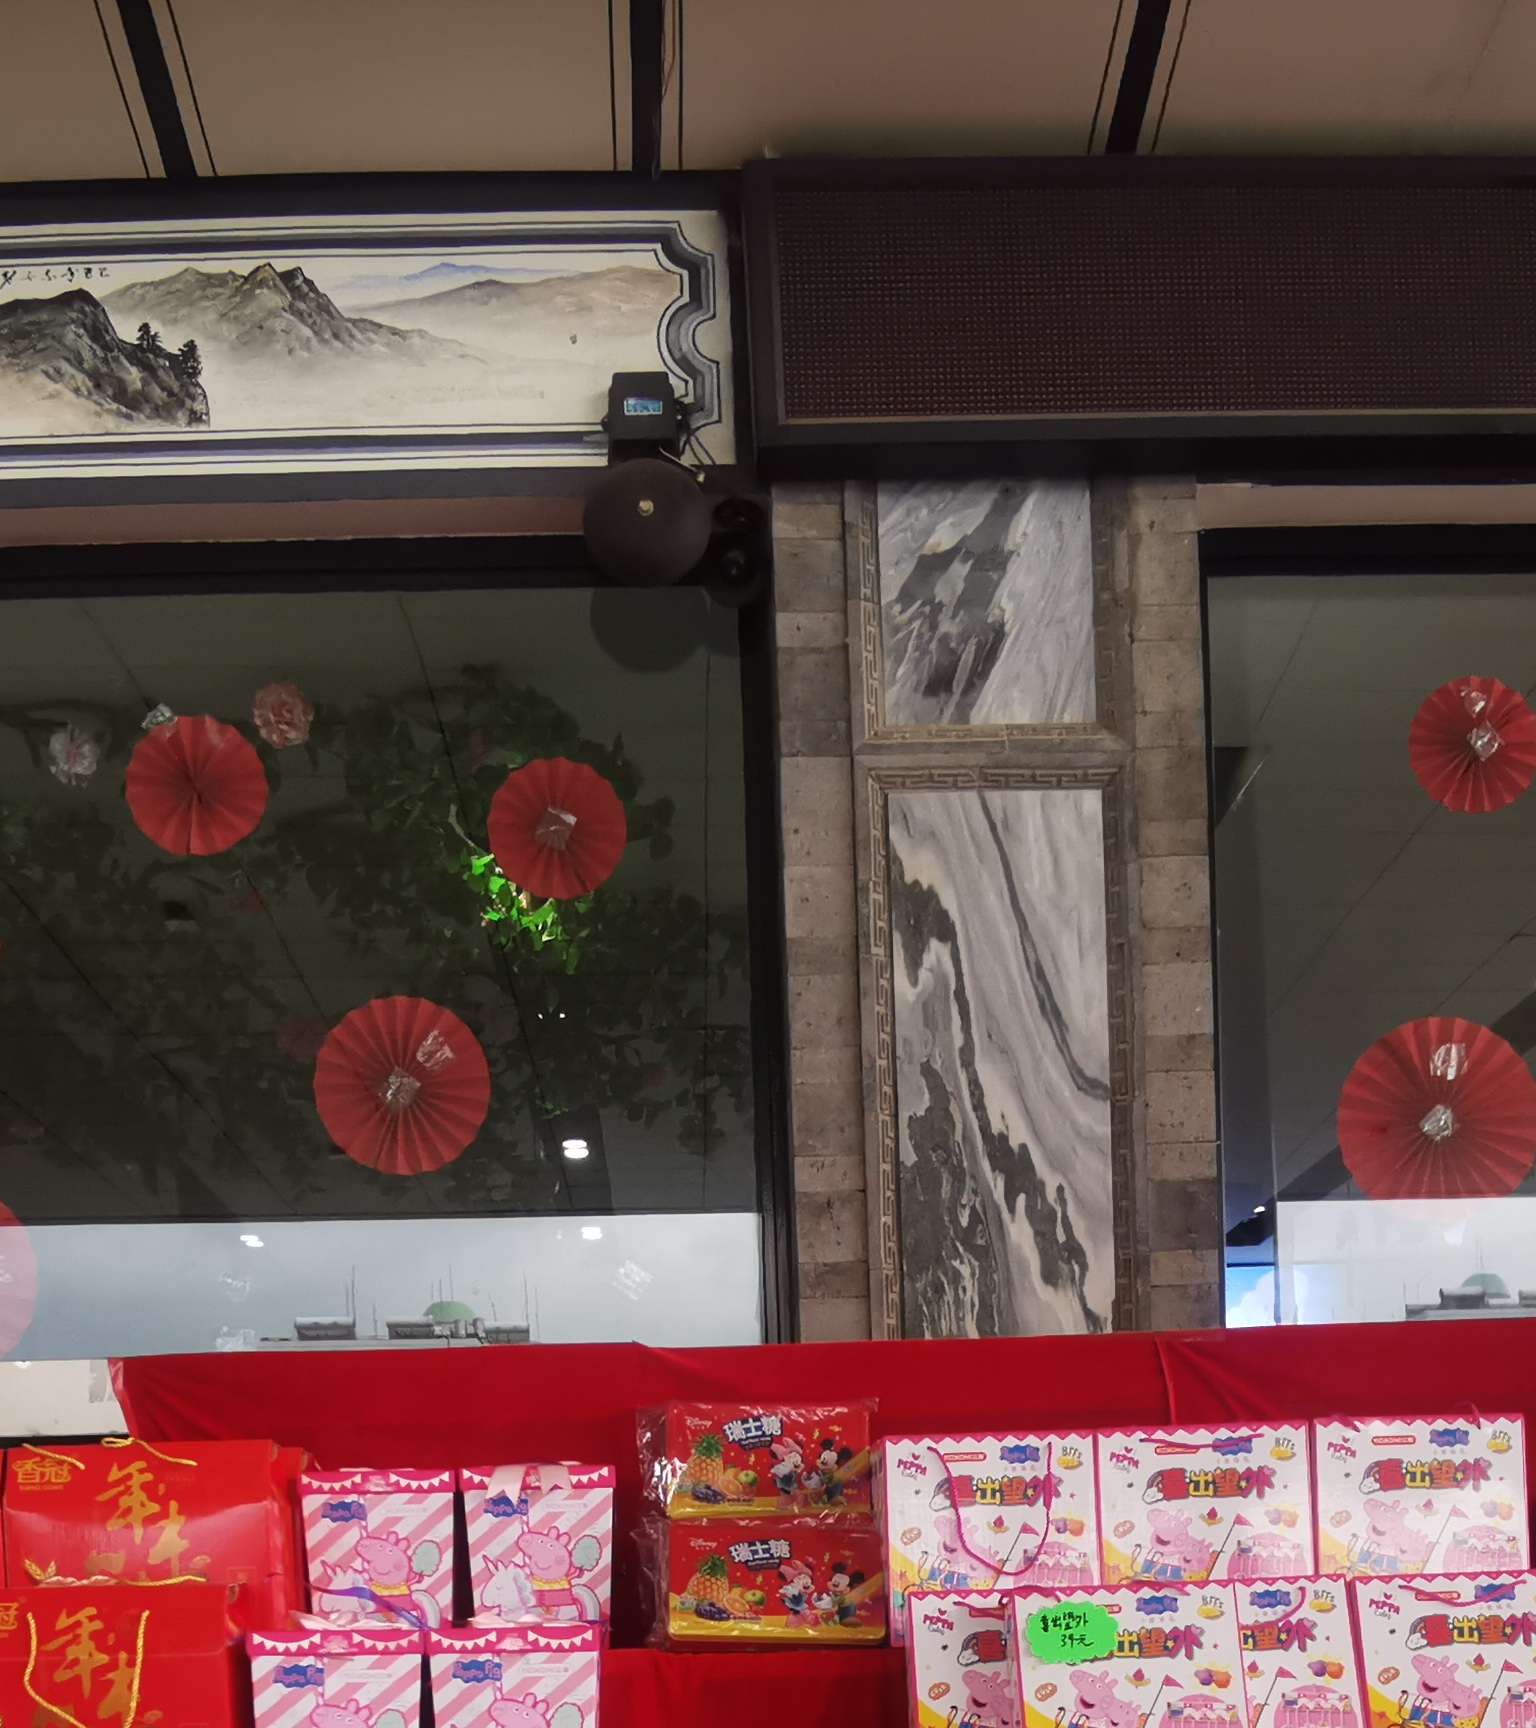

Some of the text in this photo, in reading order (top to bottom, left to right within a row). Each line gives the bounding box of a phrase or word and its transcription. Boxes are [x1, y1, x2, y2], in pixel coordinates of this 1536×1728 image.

[724, 1416, 782, 1442] 瑞士糖
[729, 1540, 791, 1562] 瑞士糖
[1115, 1624, 1204, 1661] 出望外
